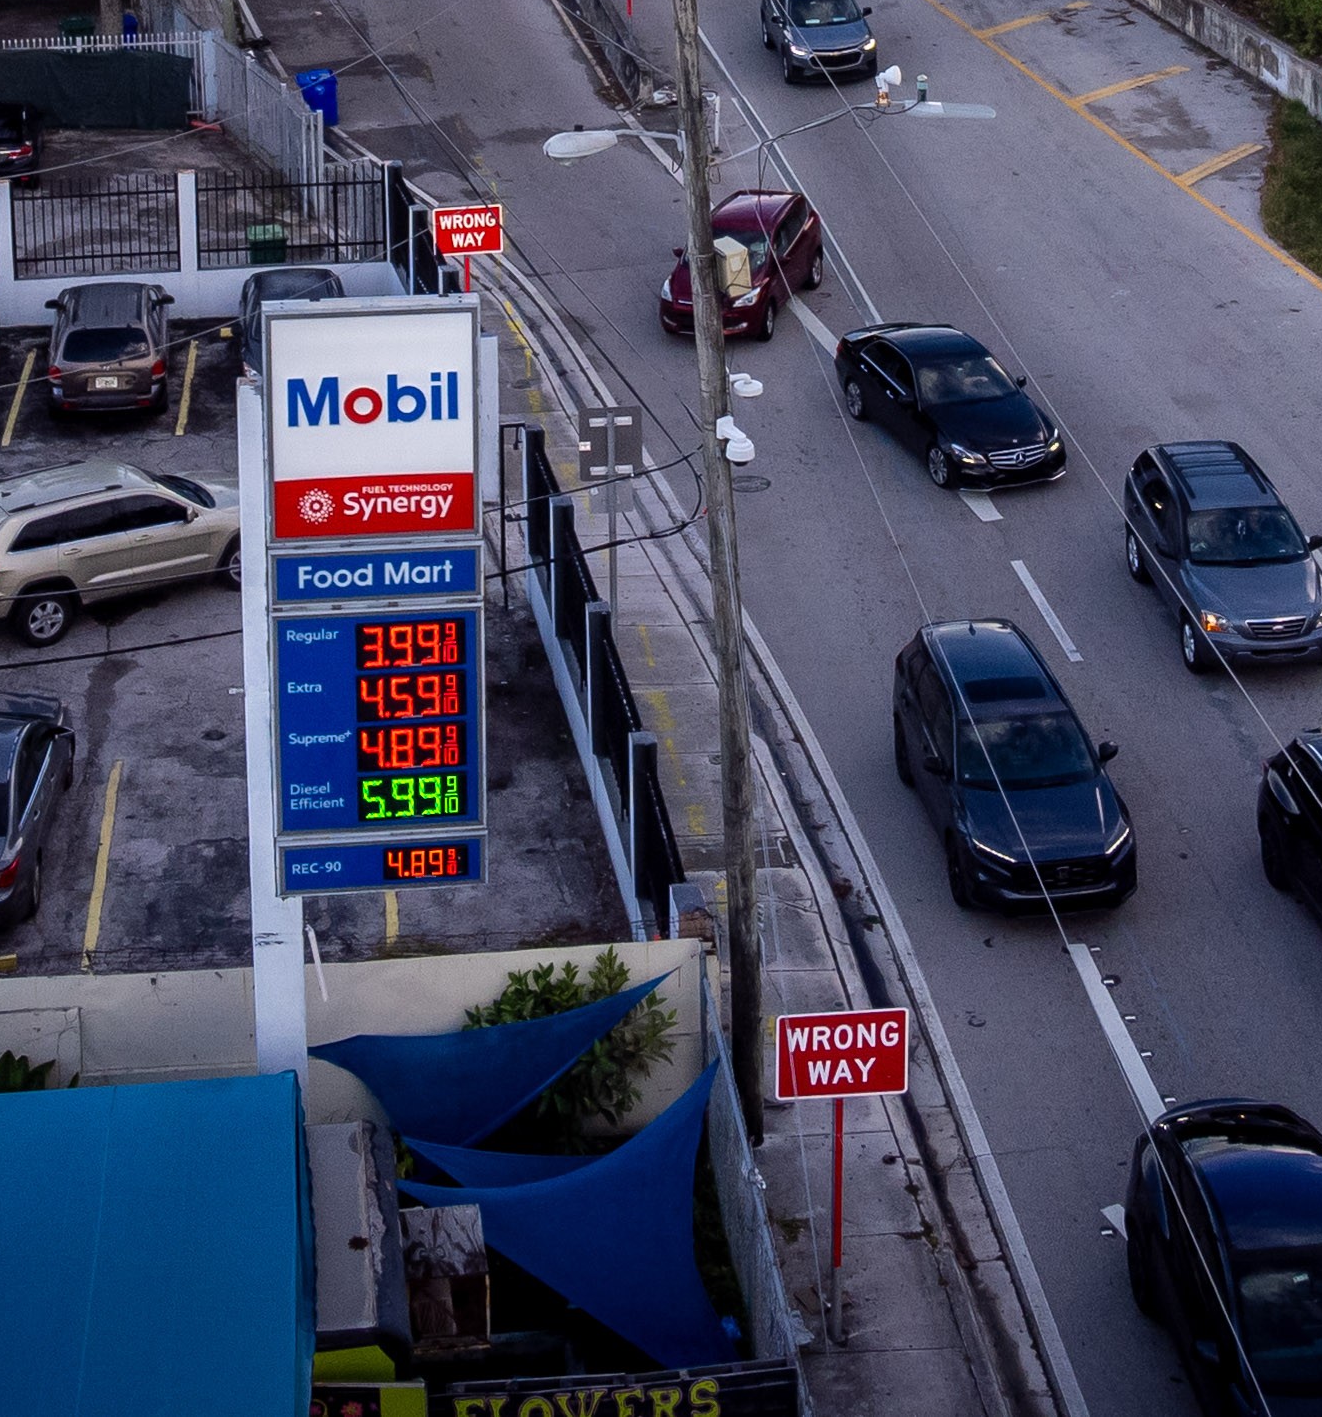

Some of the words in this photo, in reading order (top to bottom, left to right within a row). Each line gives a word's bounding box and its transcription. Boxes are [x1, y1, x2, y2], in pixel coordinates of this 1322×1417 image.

[439, 212, 496, 230] WRONG
[451, 231, 486, 248] WAY
[287, 371, 459, 427] Mobil
[361, 485, 386, 494] FUEL
[388, 483, 454, 492] TECHNOLOGY
[343, 492, 453, 521] Synergy
[297, 563, 373, 589] Food
[384, 559, 453, 585] Mart
[286, 628, 339, 644] Regular
[362, 623, 441, 668] 3.99
[287, 682, 322, 694] Extra
[360, 674, 441, 718] 4.59
[288, 730, 353, 747] Supreme+
[361, 726, 441, 768] 4.89
[290, 782, 330, 796] Diesel
[362, 776, 441, 819] 5.99
[290, 797, 345, 810] Efficient
[291, 861, 342, 875] REC-90
[387, 849, 443, 877] 4.89
[786, 1020, 899, 1053] WRONG
[807, 1057, 876, 1086] WAY
